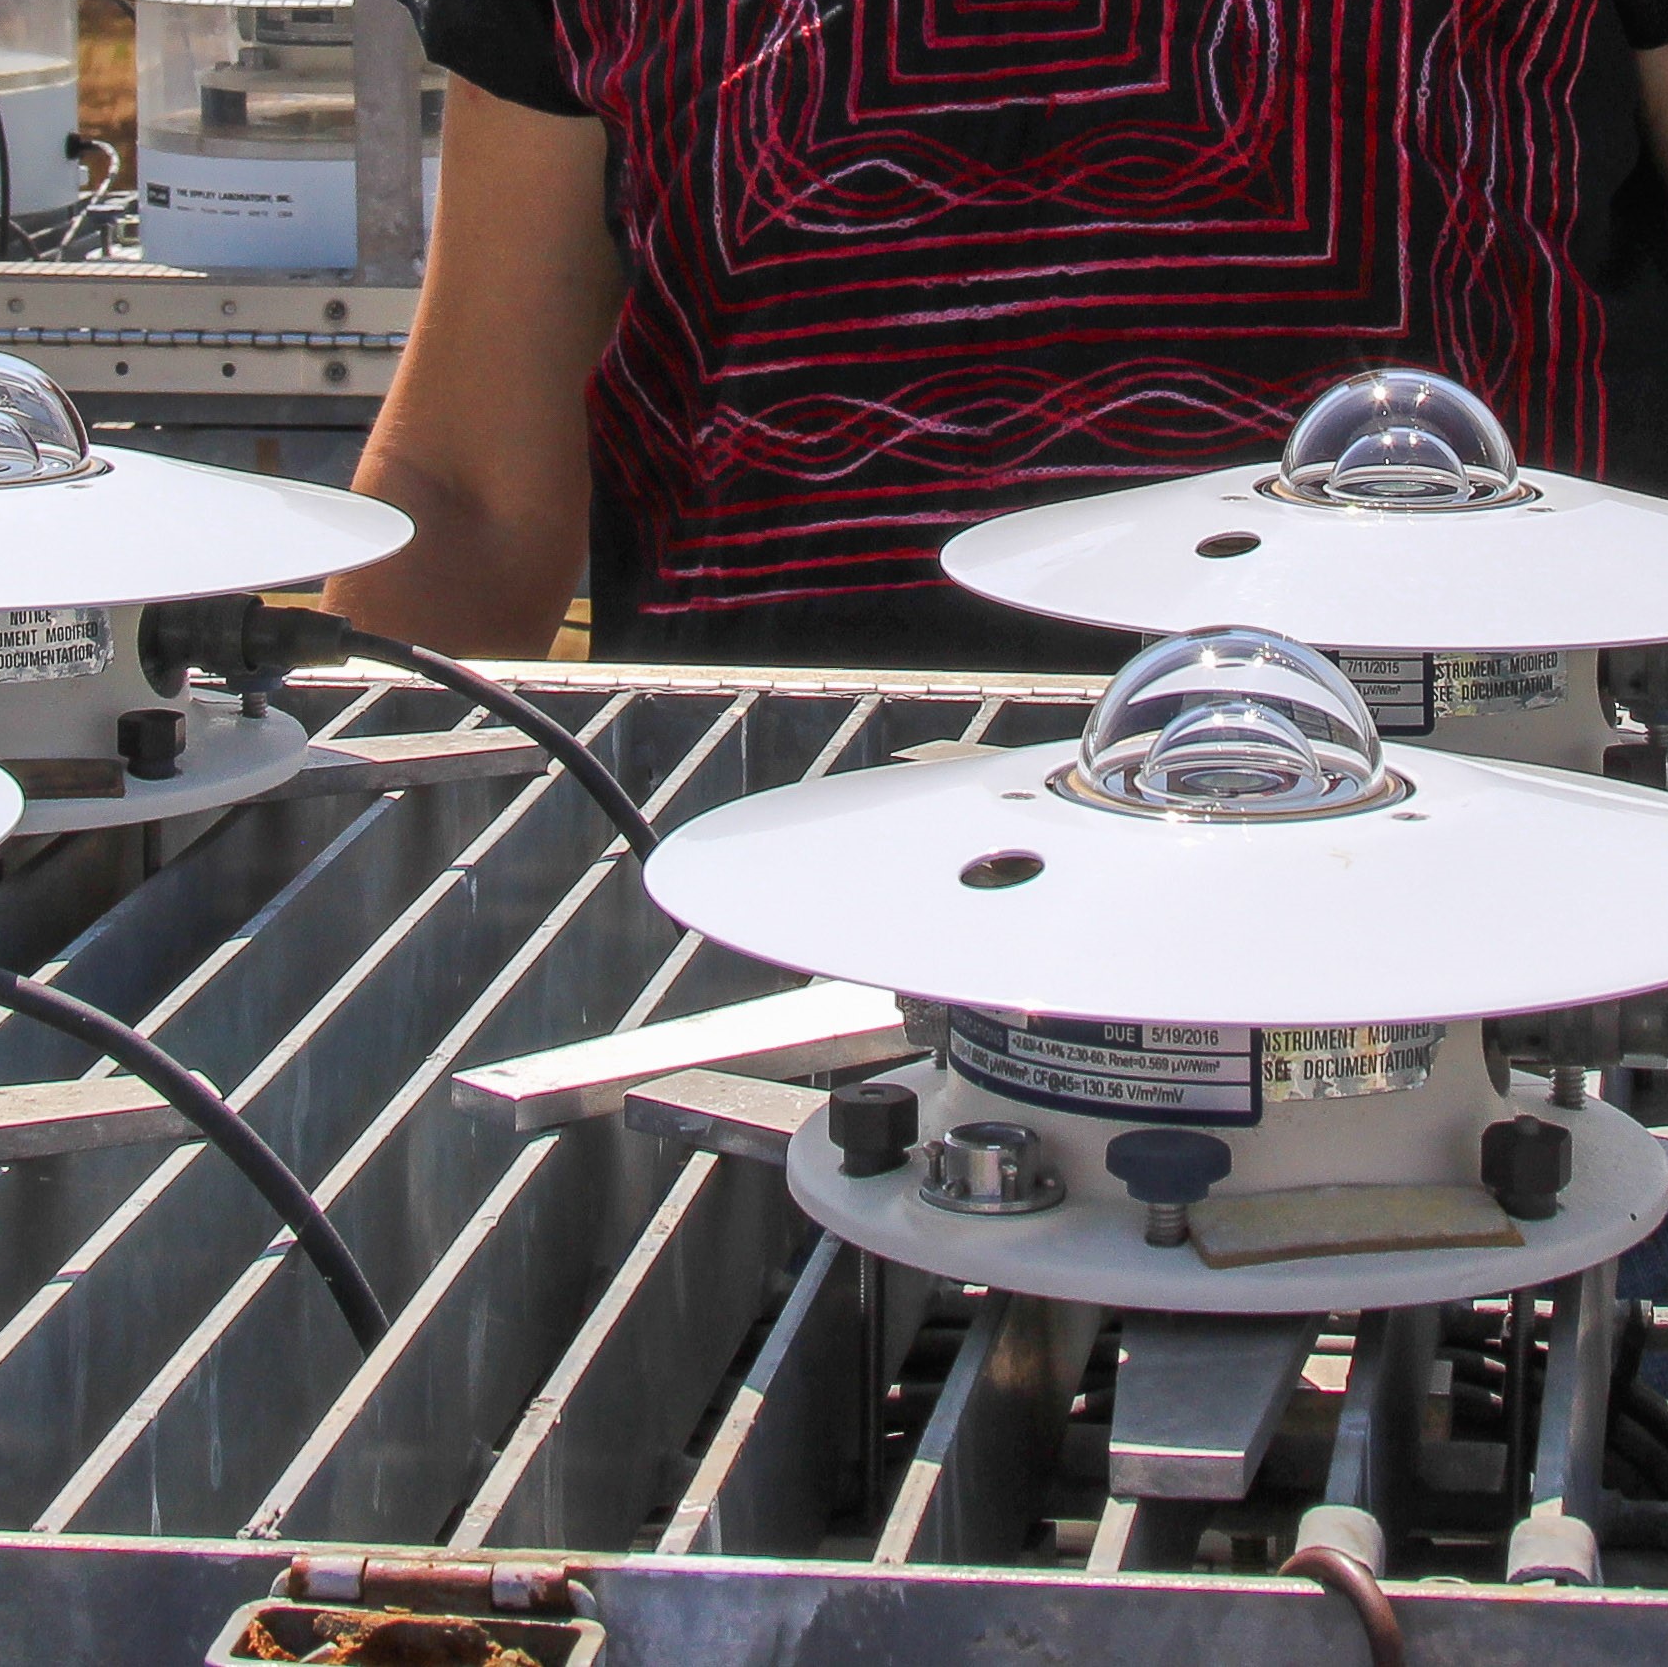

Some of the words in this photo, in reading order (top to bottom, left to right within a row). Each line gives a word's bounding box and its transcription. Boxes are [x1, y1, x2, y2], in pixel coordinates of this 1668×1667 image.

[10, 610, 52, 626] NOTICE
[45, 621, 98, 643] MODIFIED
[1347, 660, 1400, 674] 7/11/2015
[1433, 658, 1501, 680] STRUMENT
[1509, 651, 1558, 673] MODIFIED
[1433, 685, 1453, 702] SEE
[1461, 674, 1554, 701] DOCUMENTATION
[1104, 1024, 1136, 1042] DUE
[1151, 1027, 1219, 1046] 5/19/2016
[1262, 1027, 1357, 1053] NSTRUMENT
[1367, 1022, 1430, 1046] MODIFIED
[1109, 1052, 1169, 1071] Rnet=0.569
[1263, 1059, 1292, 1082] SEE
[1303, 1044, 1430, 1080] DOCUMENTATION
[1034, 1070, 1123, 1098] CF@45=130.56
[1126, 1084, 1184, 1104] V/m²/mV
